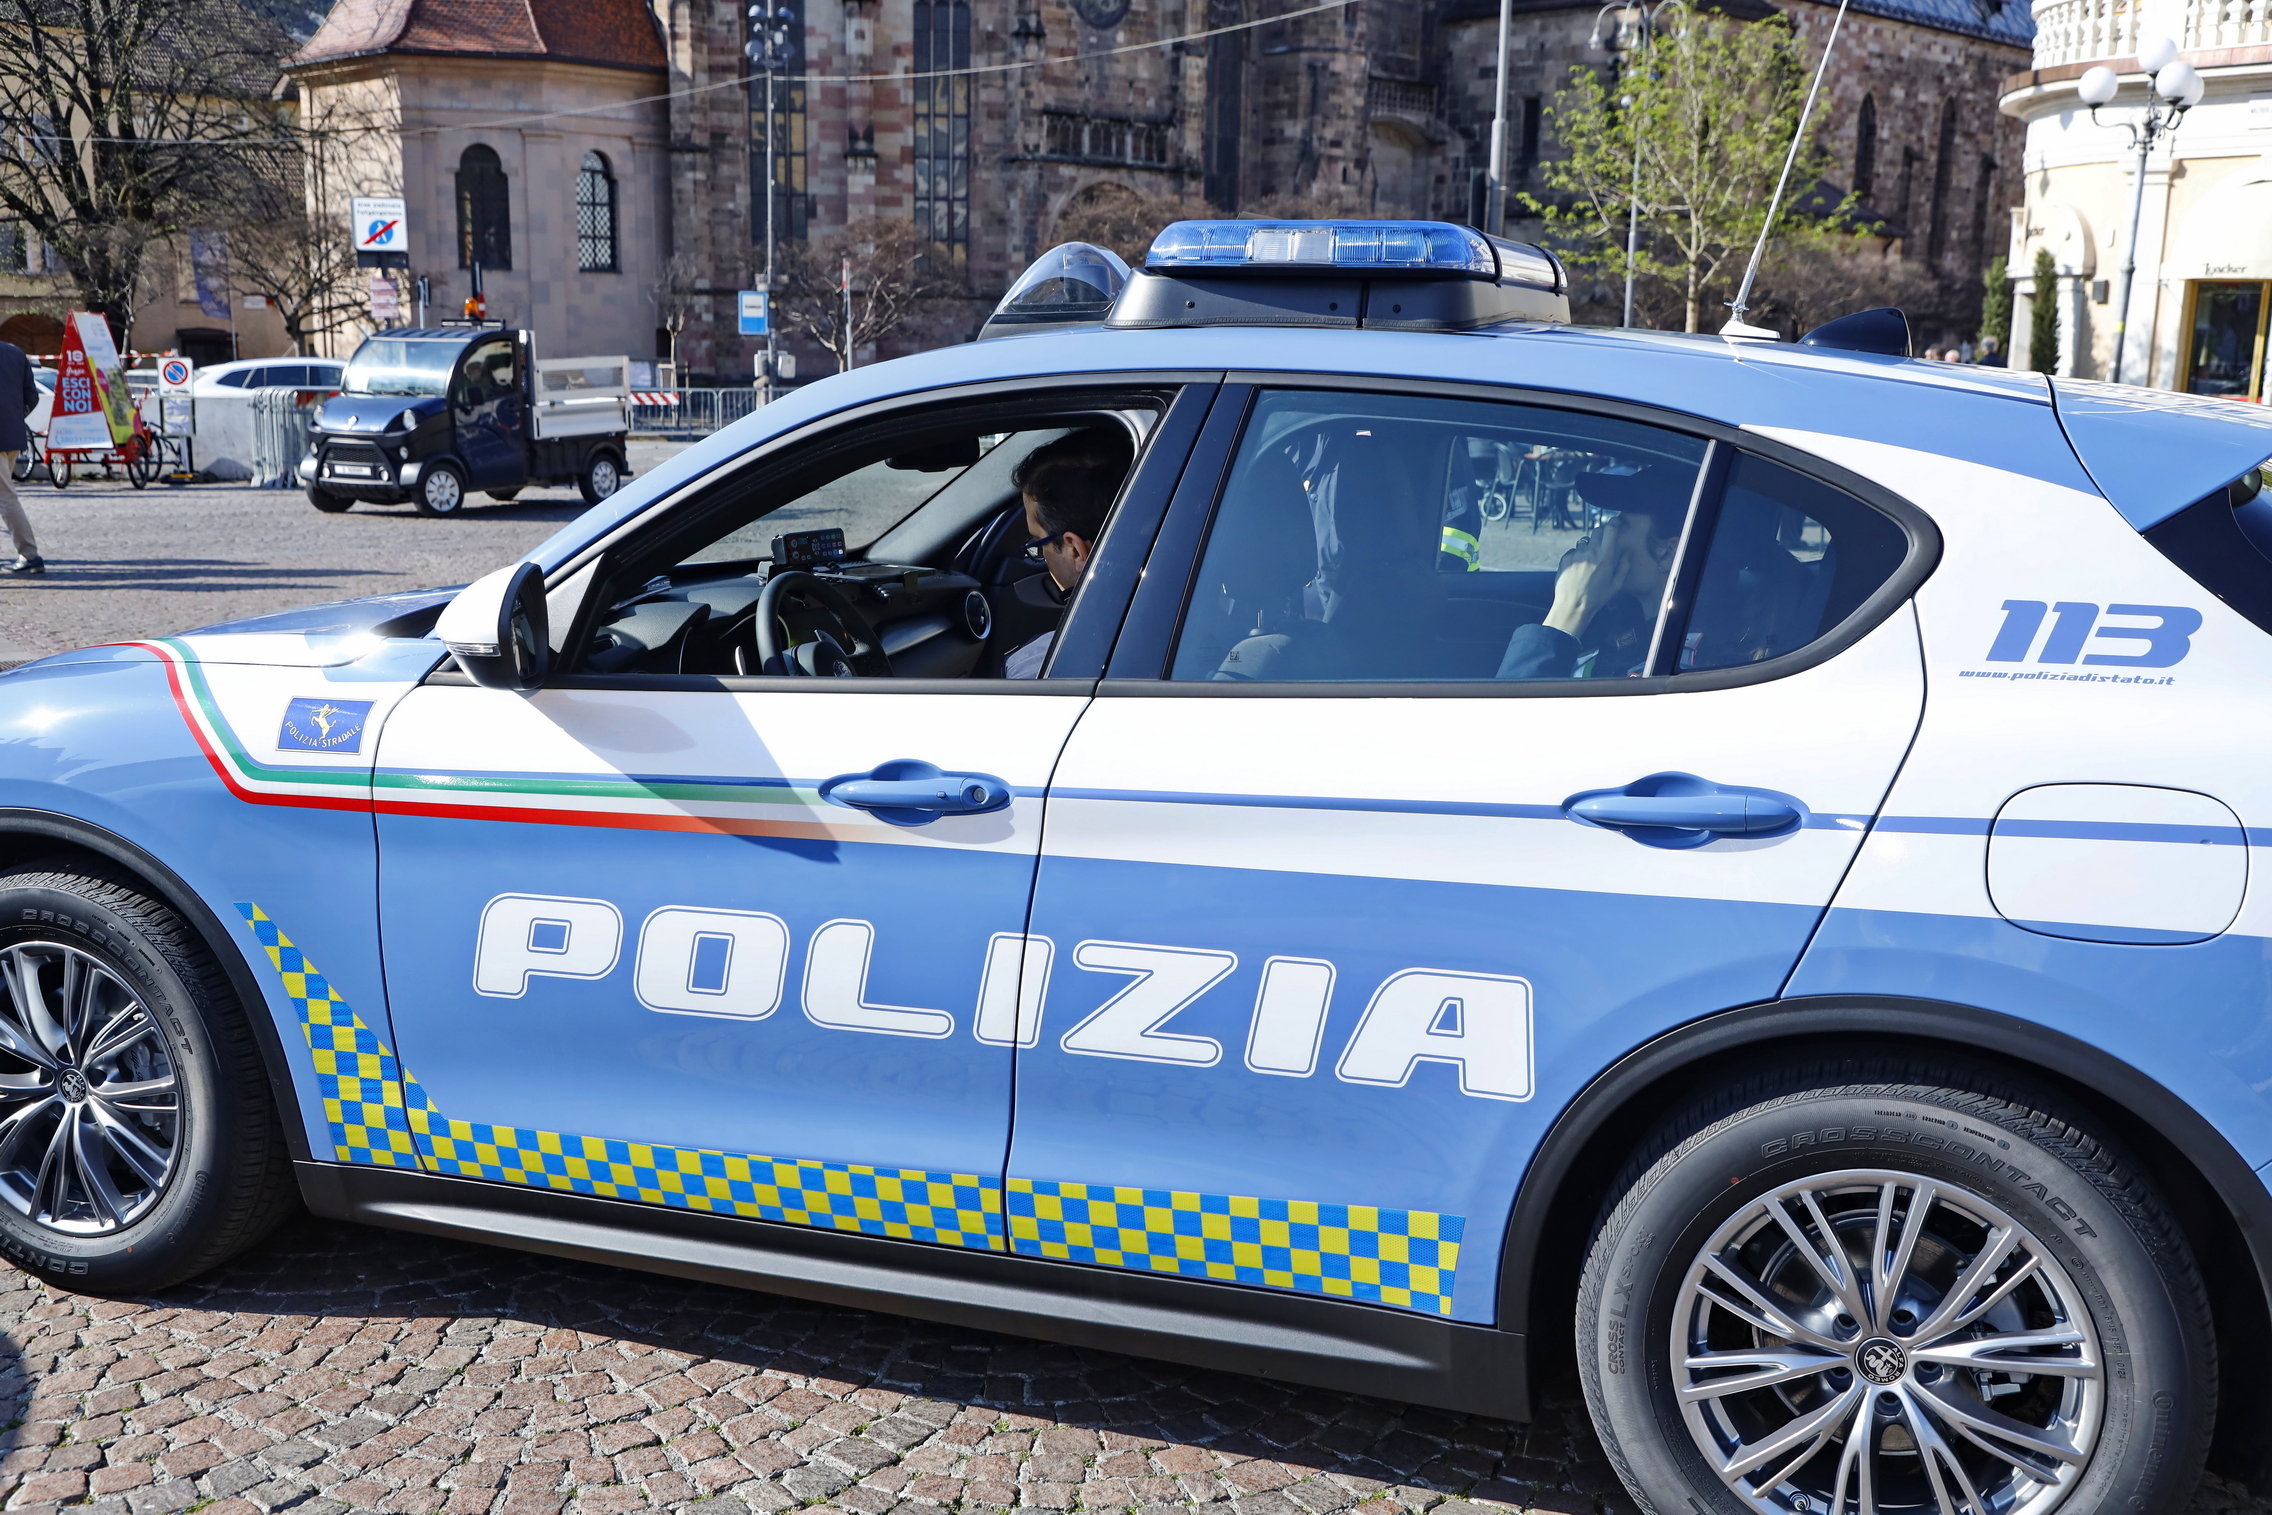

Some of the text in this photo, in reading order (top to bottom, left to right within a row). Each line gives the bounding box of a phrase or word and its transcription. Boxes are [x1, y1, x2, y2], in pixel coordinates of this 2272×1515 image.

[62, 377, 90, 388] ESCI
[62, 389, 91, 399] CON
[64, 401, 92, 412] NOI
[1985, 599, 2203, 669] 113
[1958, 670, 2175, 686] www.poliziadistato.it
[284, 720, 361, 748] POLIZIA STRADALE
[22, 908, 193, 1055] CROSSCONTACT
[472, 892, 1535, 1103] POLIZIA
[1761, 1126, 2098, 1239] CROSSCONTACT
[1610, 1225, 1649, 1319] LX SPORT
[1608, 1320, 1619, 1374] CROSS
[1618, 1322, 1626, 1375] CONTACT
[1868, 1347, 1904, 1383] ALFA ROMEO
